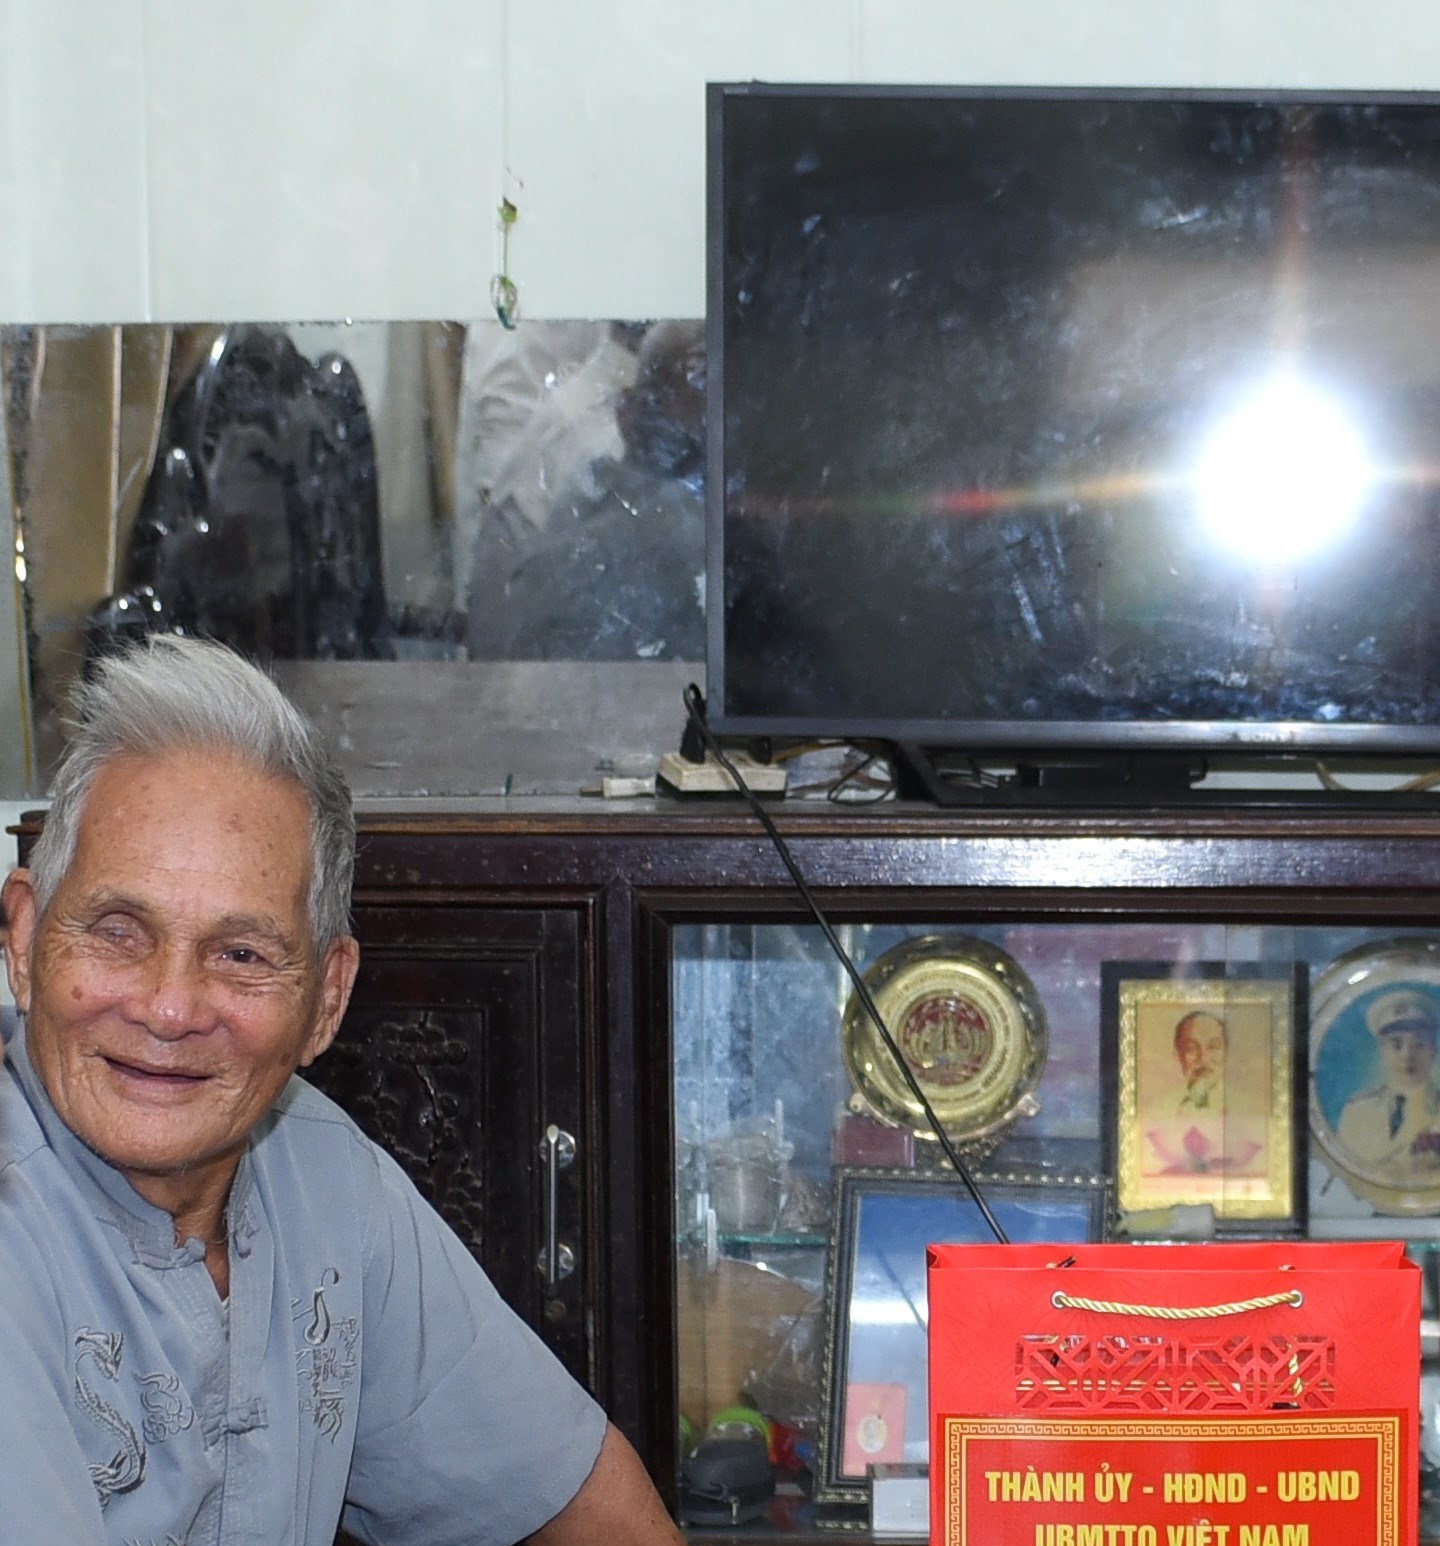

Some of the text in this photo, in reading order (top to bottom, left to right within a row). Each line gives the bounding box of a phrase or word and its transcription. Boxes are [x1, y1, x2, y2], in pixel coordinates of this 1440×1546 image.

[985, 1465, 1085, 1502] THÀNH
[1094, 1462, 1133, 1503] ỦY
[1142, 1486, 1154, 1494] -
[1164, 1472, 1247, 1503] HĐND
[1277, 1470, 1360, 1502] UBND
